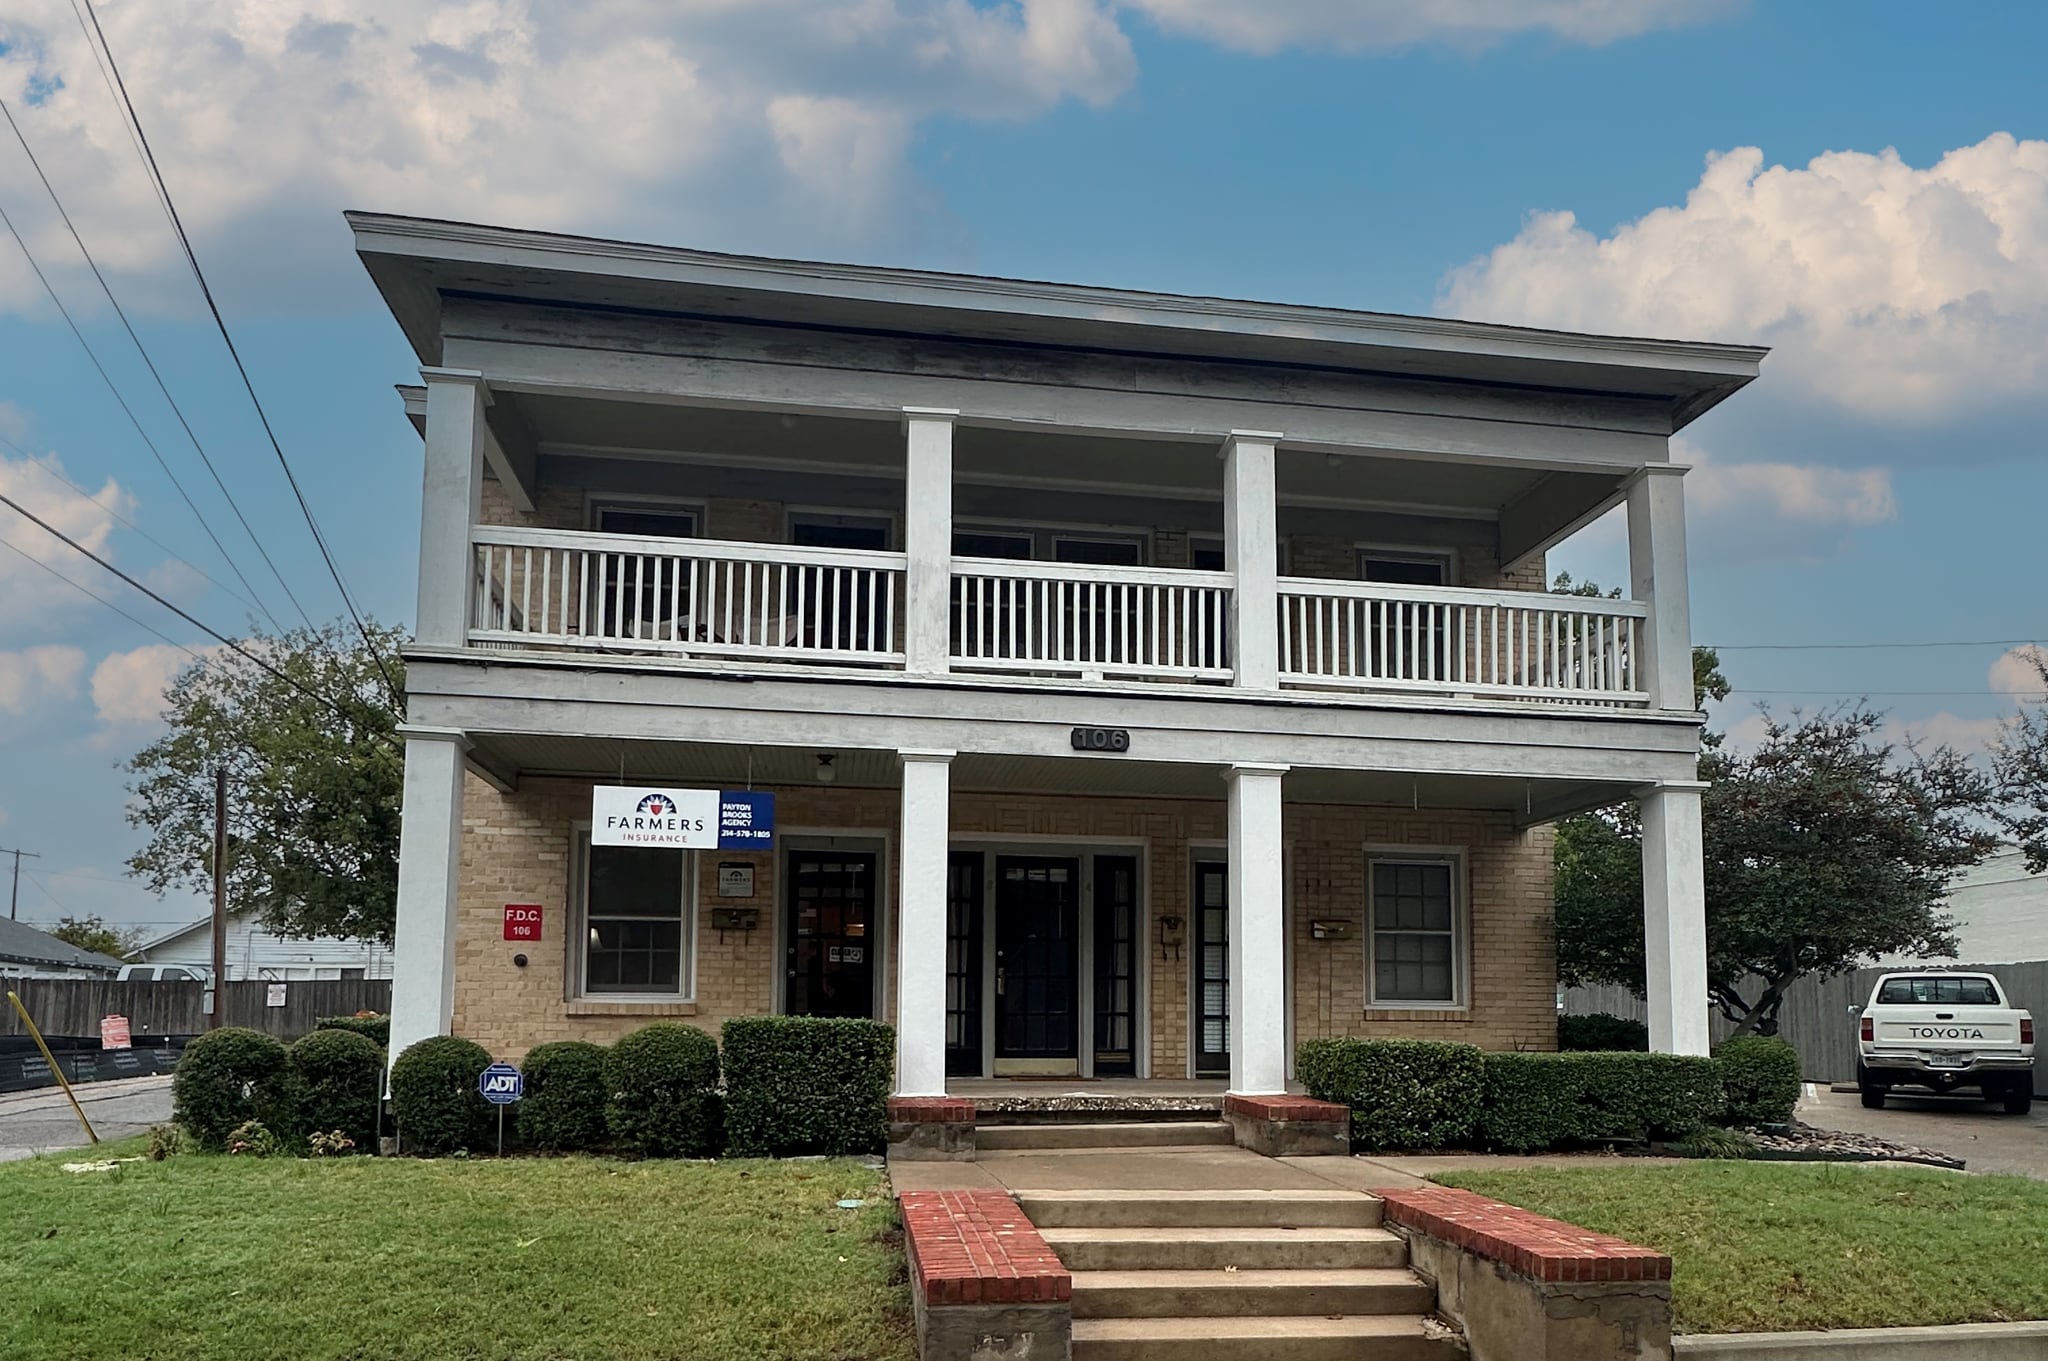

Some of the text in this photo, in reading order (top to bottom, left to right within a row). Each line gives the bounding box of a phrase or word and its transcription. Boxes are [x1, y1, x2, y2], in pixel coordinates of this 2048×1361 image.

[1078, 729, 1125, 749] 106
[722, 803, 752, 811] PAYTON
[722, 811, 753, 819] BROOKS
[607, 816, 704, 831] FARMERS
[721, 818, 752, 827] AGENCY
[622, 833, 688, 843] INSURANCE
[506, 909, 541, 921] F.D.C.
[513, 926, 531, 936] 106
[1908, 1027, 1984, 1039] TOYOTA
[485, 1075, 519, 1092] ADT
